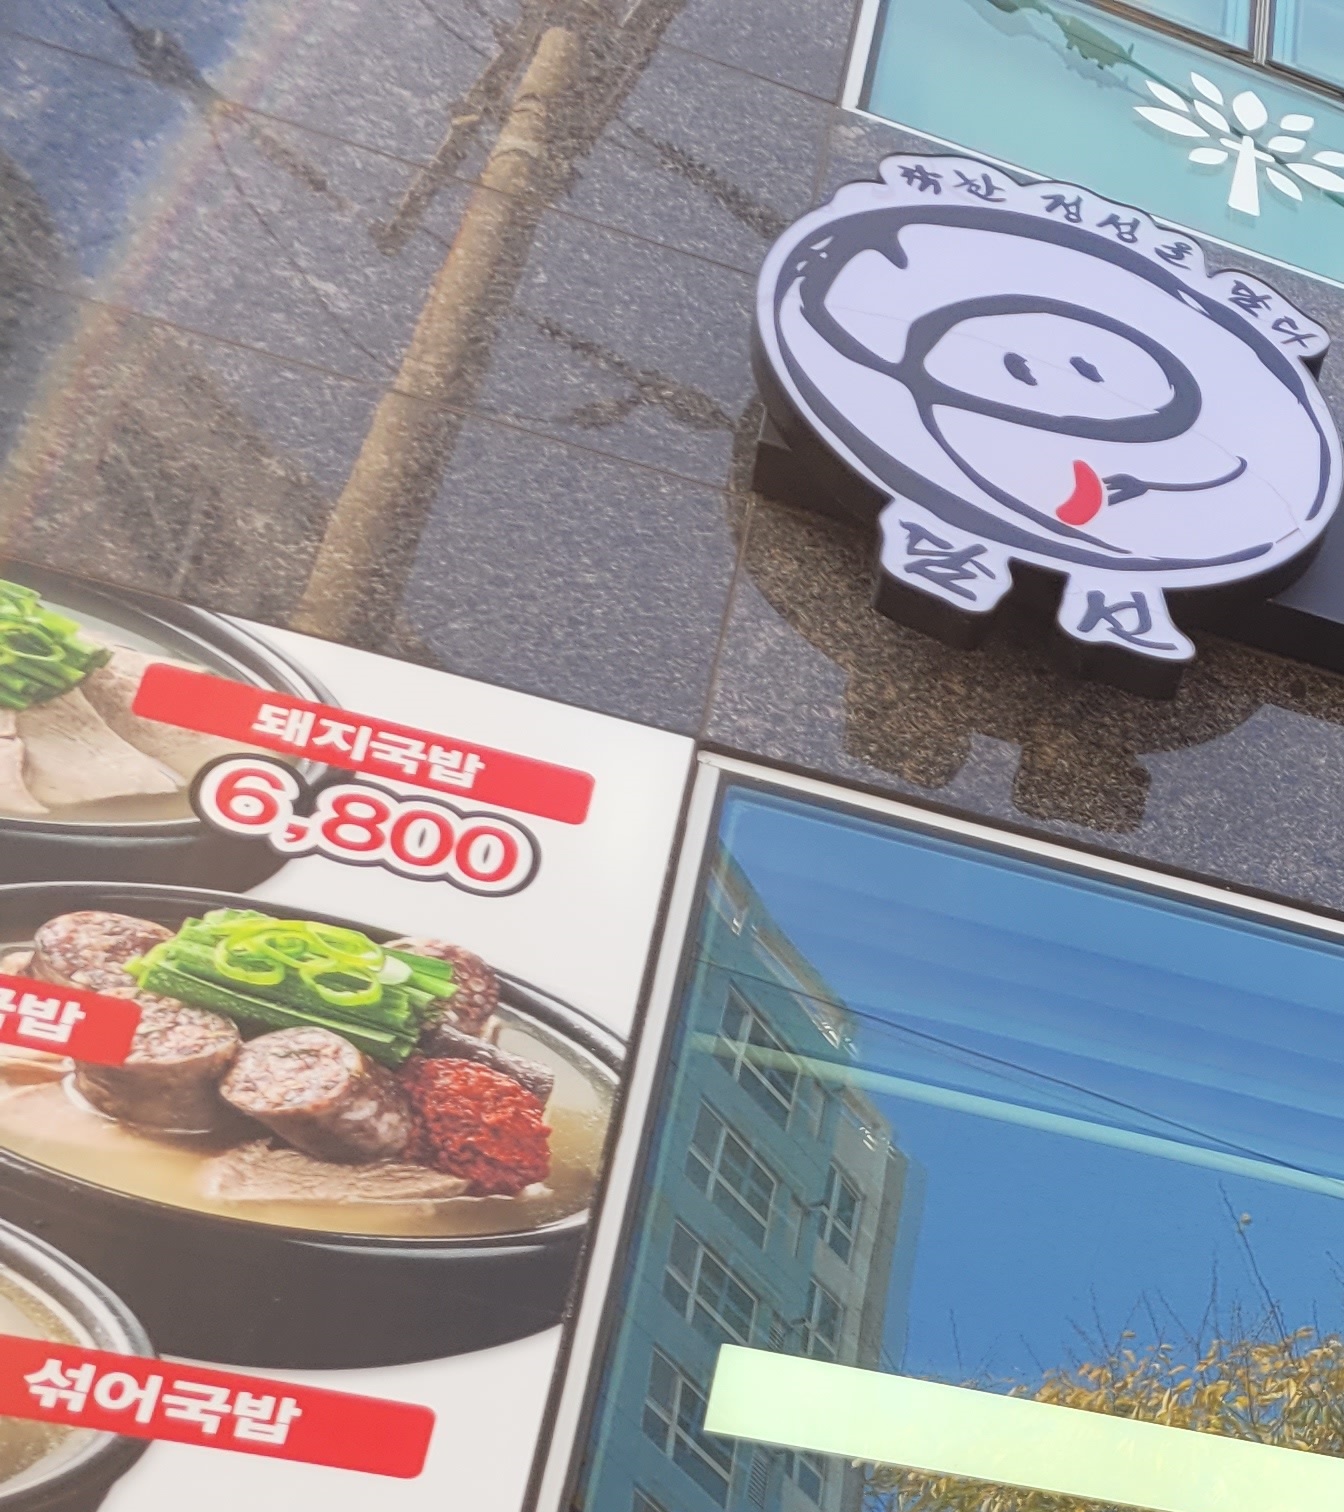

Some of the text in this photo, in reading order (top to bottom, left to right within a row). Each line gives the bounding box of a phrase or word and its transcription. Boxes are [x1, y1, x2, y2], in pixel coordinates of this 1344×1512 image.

[1042, 194, 1192, 270] 정성을
[1229, 280, 1320, 349] 담다
[251, 704, 486, 789] 돼지국밥
[200, 758, 533, 892] 6,800
[0, 987, 86, 1043] 밥
[23, 1358, 302, 1445] 섞어국밥
